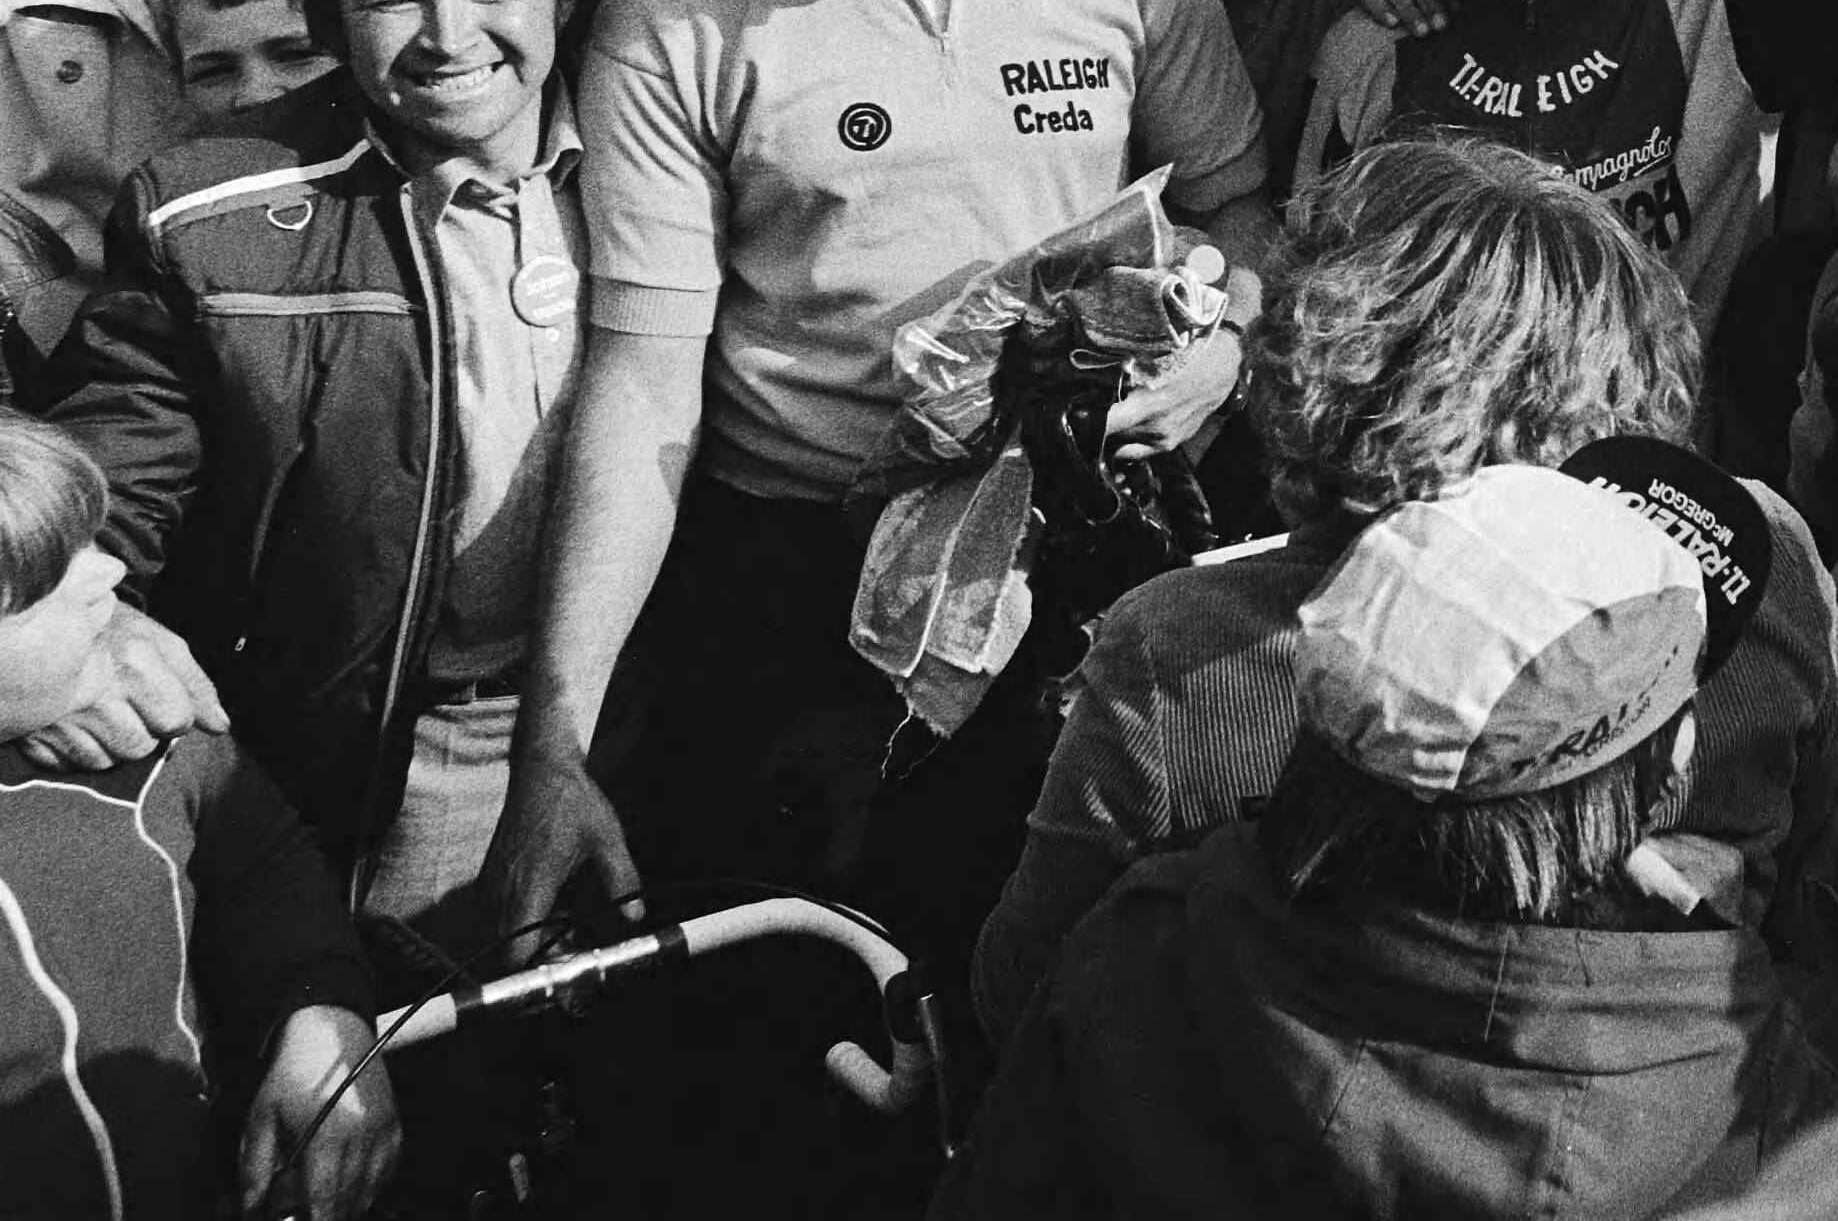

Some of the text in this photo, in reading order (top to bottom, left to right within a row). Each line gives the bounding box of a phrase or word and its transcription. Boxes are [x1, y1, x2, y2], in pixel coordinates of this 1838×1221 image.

[1000, 58, 1110, 96] RALEIGH
[1013, 100, 1094, 135] Creda
[1648, 478, 1735, 547] McGREGOR
